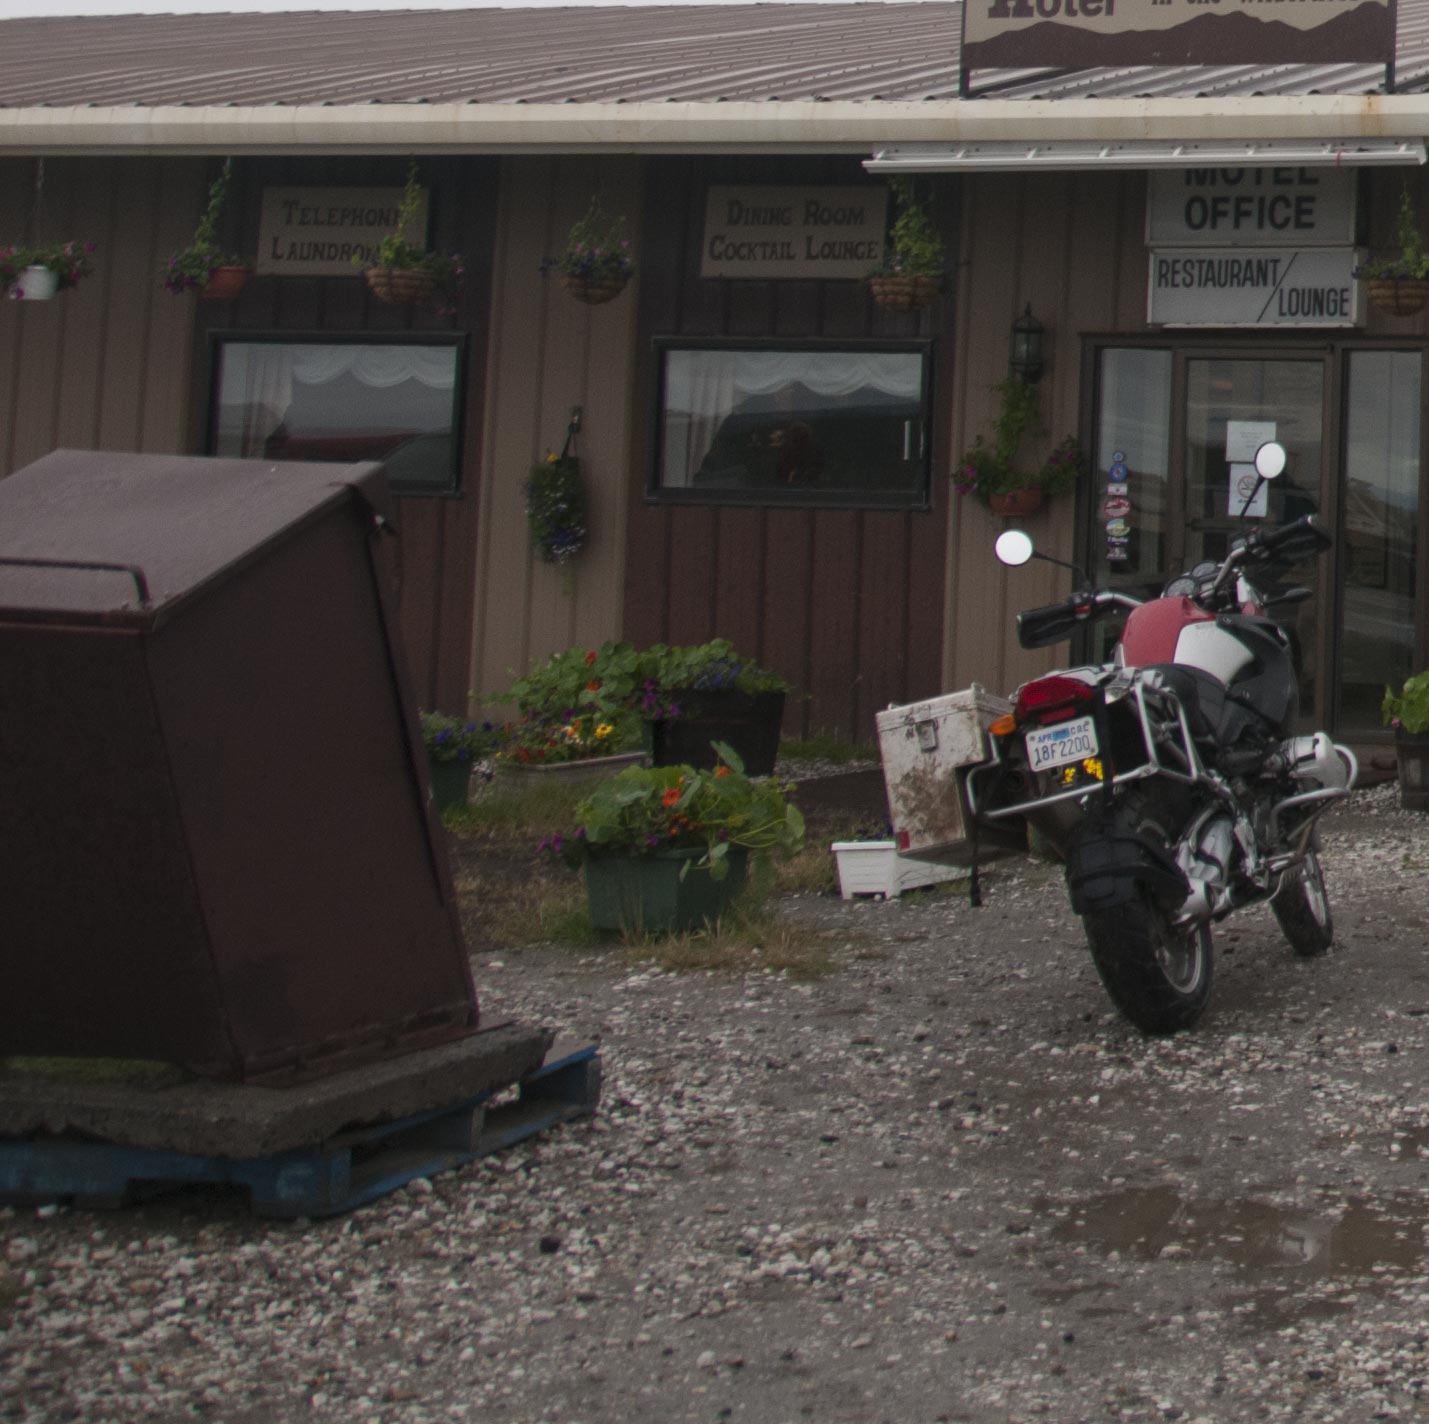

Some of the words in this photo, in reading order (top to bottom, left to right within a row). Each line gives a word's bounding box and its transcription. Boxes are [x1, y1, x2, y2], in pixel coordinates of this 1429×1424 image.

[726, 199, 793, 226] DINING
[803, 198, 865, 226] ROOM
[1184, 195, 1317, 231] OFFICE
[271, 236, 402, 262] LAUNDRO
[709, 234, 796, 261] COCKTAIL
[805, 235, 880, 261] LOUNGE
[1158, 258, 1281, 288] RESTAURANT
[1278, 287, 1349, 317] LOUNGE
[1034, 734, 1091, 764] 18F2200
